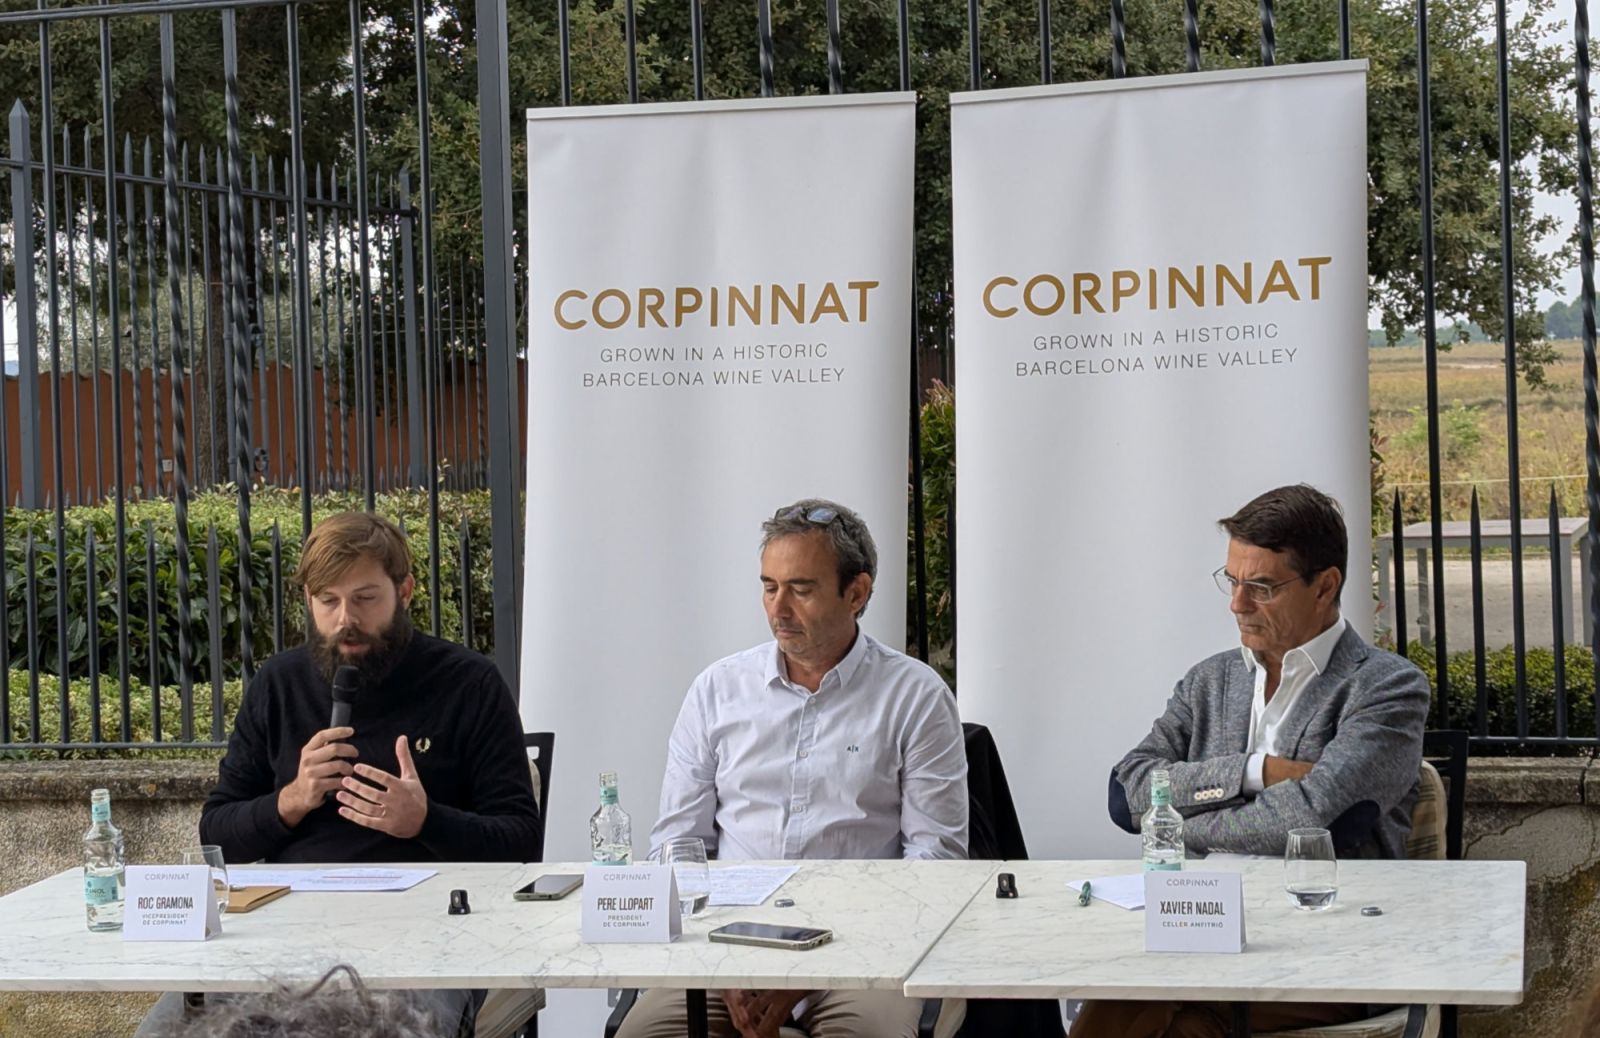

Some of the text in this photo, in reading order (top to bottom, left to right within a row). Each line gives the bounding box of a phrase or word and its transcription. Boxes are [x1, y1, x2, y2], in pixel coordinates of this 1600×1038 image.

[982, 256, 1332, 318] CORPINNAT
[554, 280, 880, 330] CORPINNAT
[1033, 323, 1279, 351] GROWN IN A HISTORIC
[600, 342, 828, 363] GROWN IN A HISTORIC
[1016, 347, 1298, 377] BARCELONA WINE VALLEY
[583, 367, 846, 387] BARCELONA WINE VALLEY
[603, 873, 651, 881] CORPINNAT
[1166, 879, 1219, 887] CORPINNAT
[138, 897, 193, 909] ROC GRAMONA
[597, 897, 654, 910] PERE LLOPART
[1160, 901, 1225, 915] XAVIER NADAL
